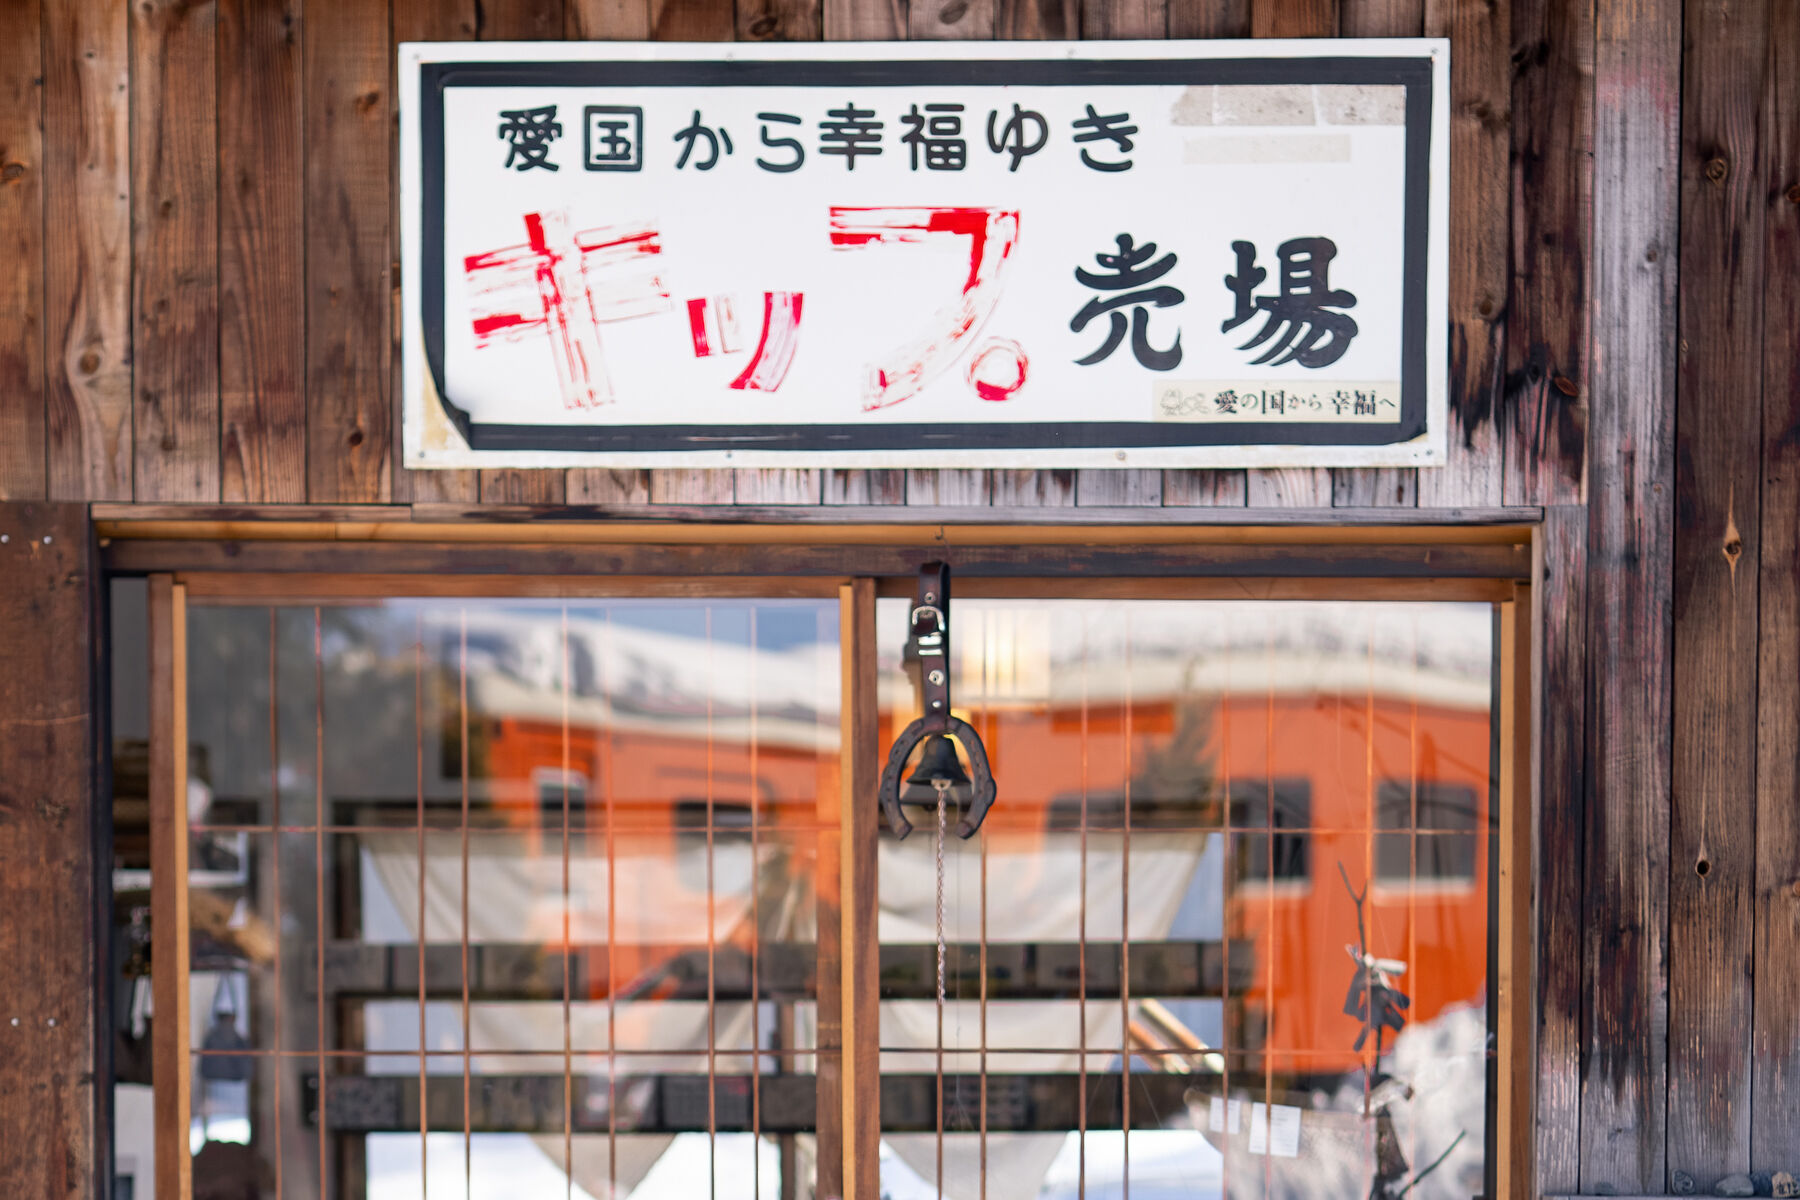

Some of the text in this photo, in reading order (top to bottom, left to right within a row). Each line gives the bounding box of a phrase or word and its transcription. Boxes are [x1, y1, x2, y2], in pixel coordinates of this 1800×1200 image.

[498, 102, 1139, 174] 愛国から幸福ゆき
[1214, 389, 1397, 416] 愛の国から幸福へ
